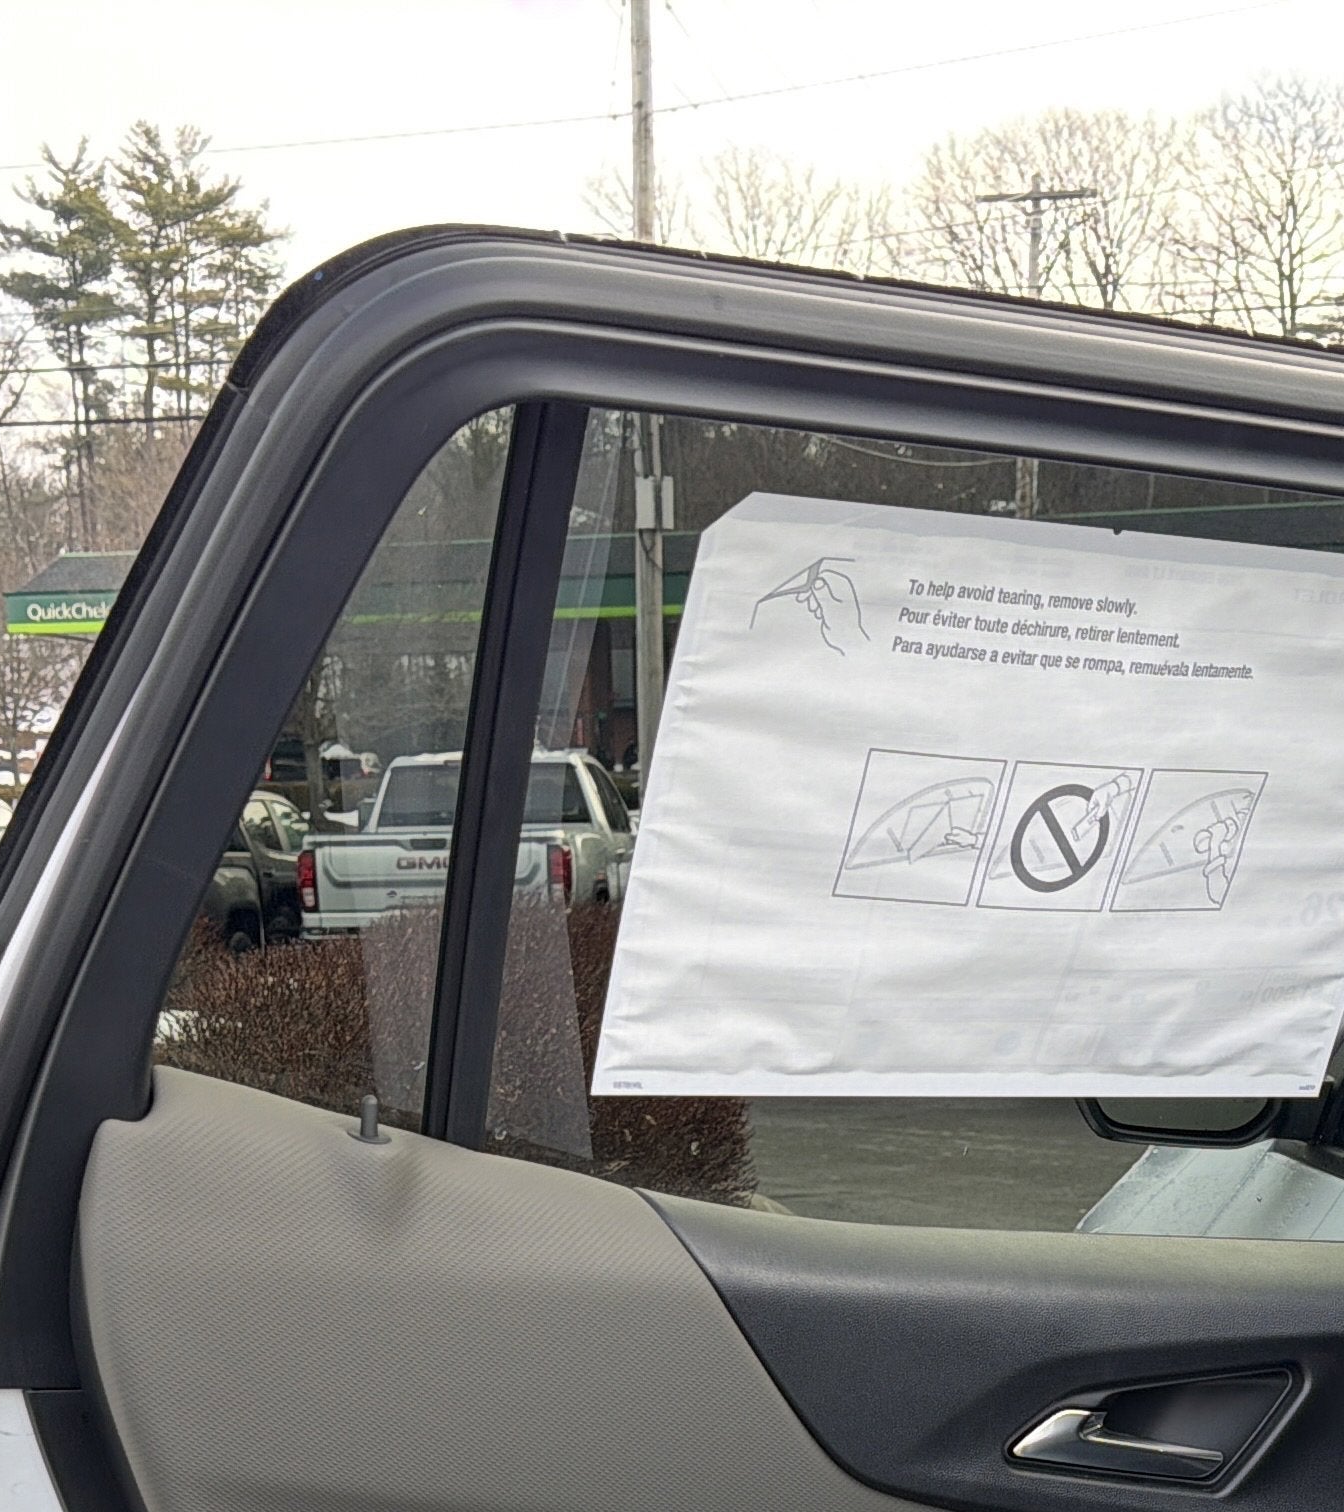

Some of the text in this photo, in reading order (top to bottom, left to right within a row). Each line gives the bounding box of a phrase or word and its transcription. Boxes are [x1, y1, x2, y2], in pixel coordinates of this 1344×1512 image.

[908, 579, 1137, 617] To help avoid tearing, remove slowly.
[898, 607, 1180, 648] Pour éviter toute déchirure, retirer lentement.
[892, 636, 1254, 680] Para ayudarse a evitar que se rompa, remuévala lentamente.
